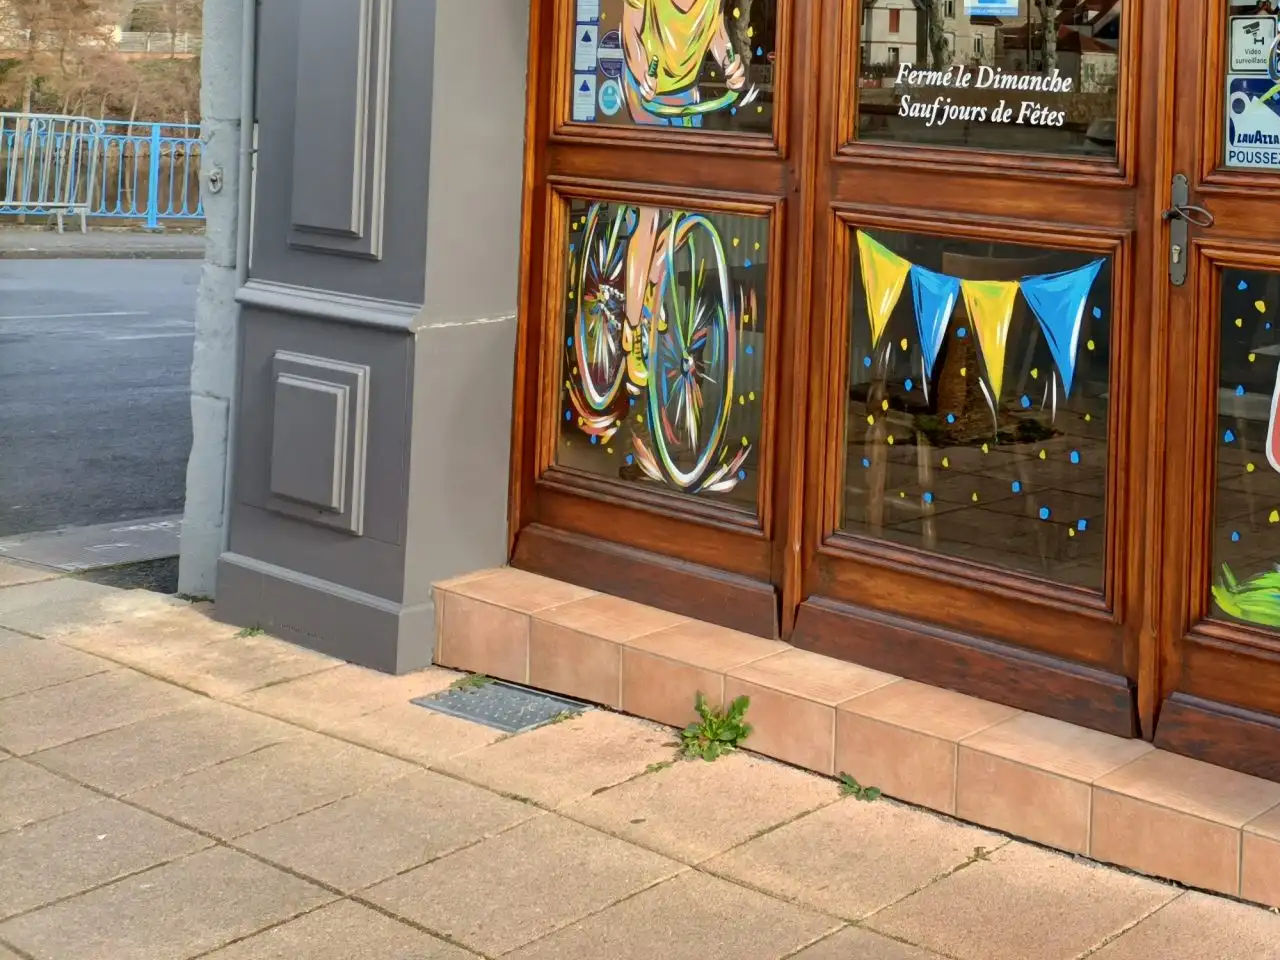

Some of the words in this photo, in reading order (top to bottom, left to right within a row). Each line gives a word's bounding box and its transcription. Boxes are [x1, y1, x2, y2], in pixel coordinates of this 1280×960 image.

[1235, 56, 1267, 65] surveillanc
[895, 62, 953, 87] Fermé
[956, 66, 971, 89] le
[975, 65, 1072, 93] Dimanche
[898, 94, 943, 127] Sauf
[937, 97, 987, 127] jours
[991, 100, 1013, 124] de
[1015, 100, 1065, 127] Fêtes
[1236, 129, 1280, 145] LAVAZZA
